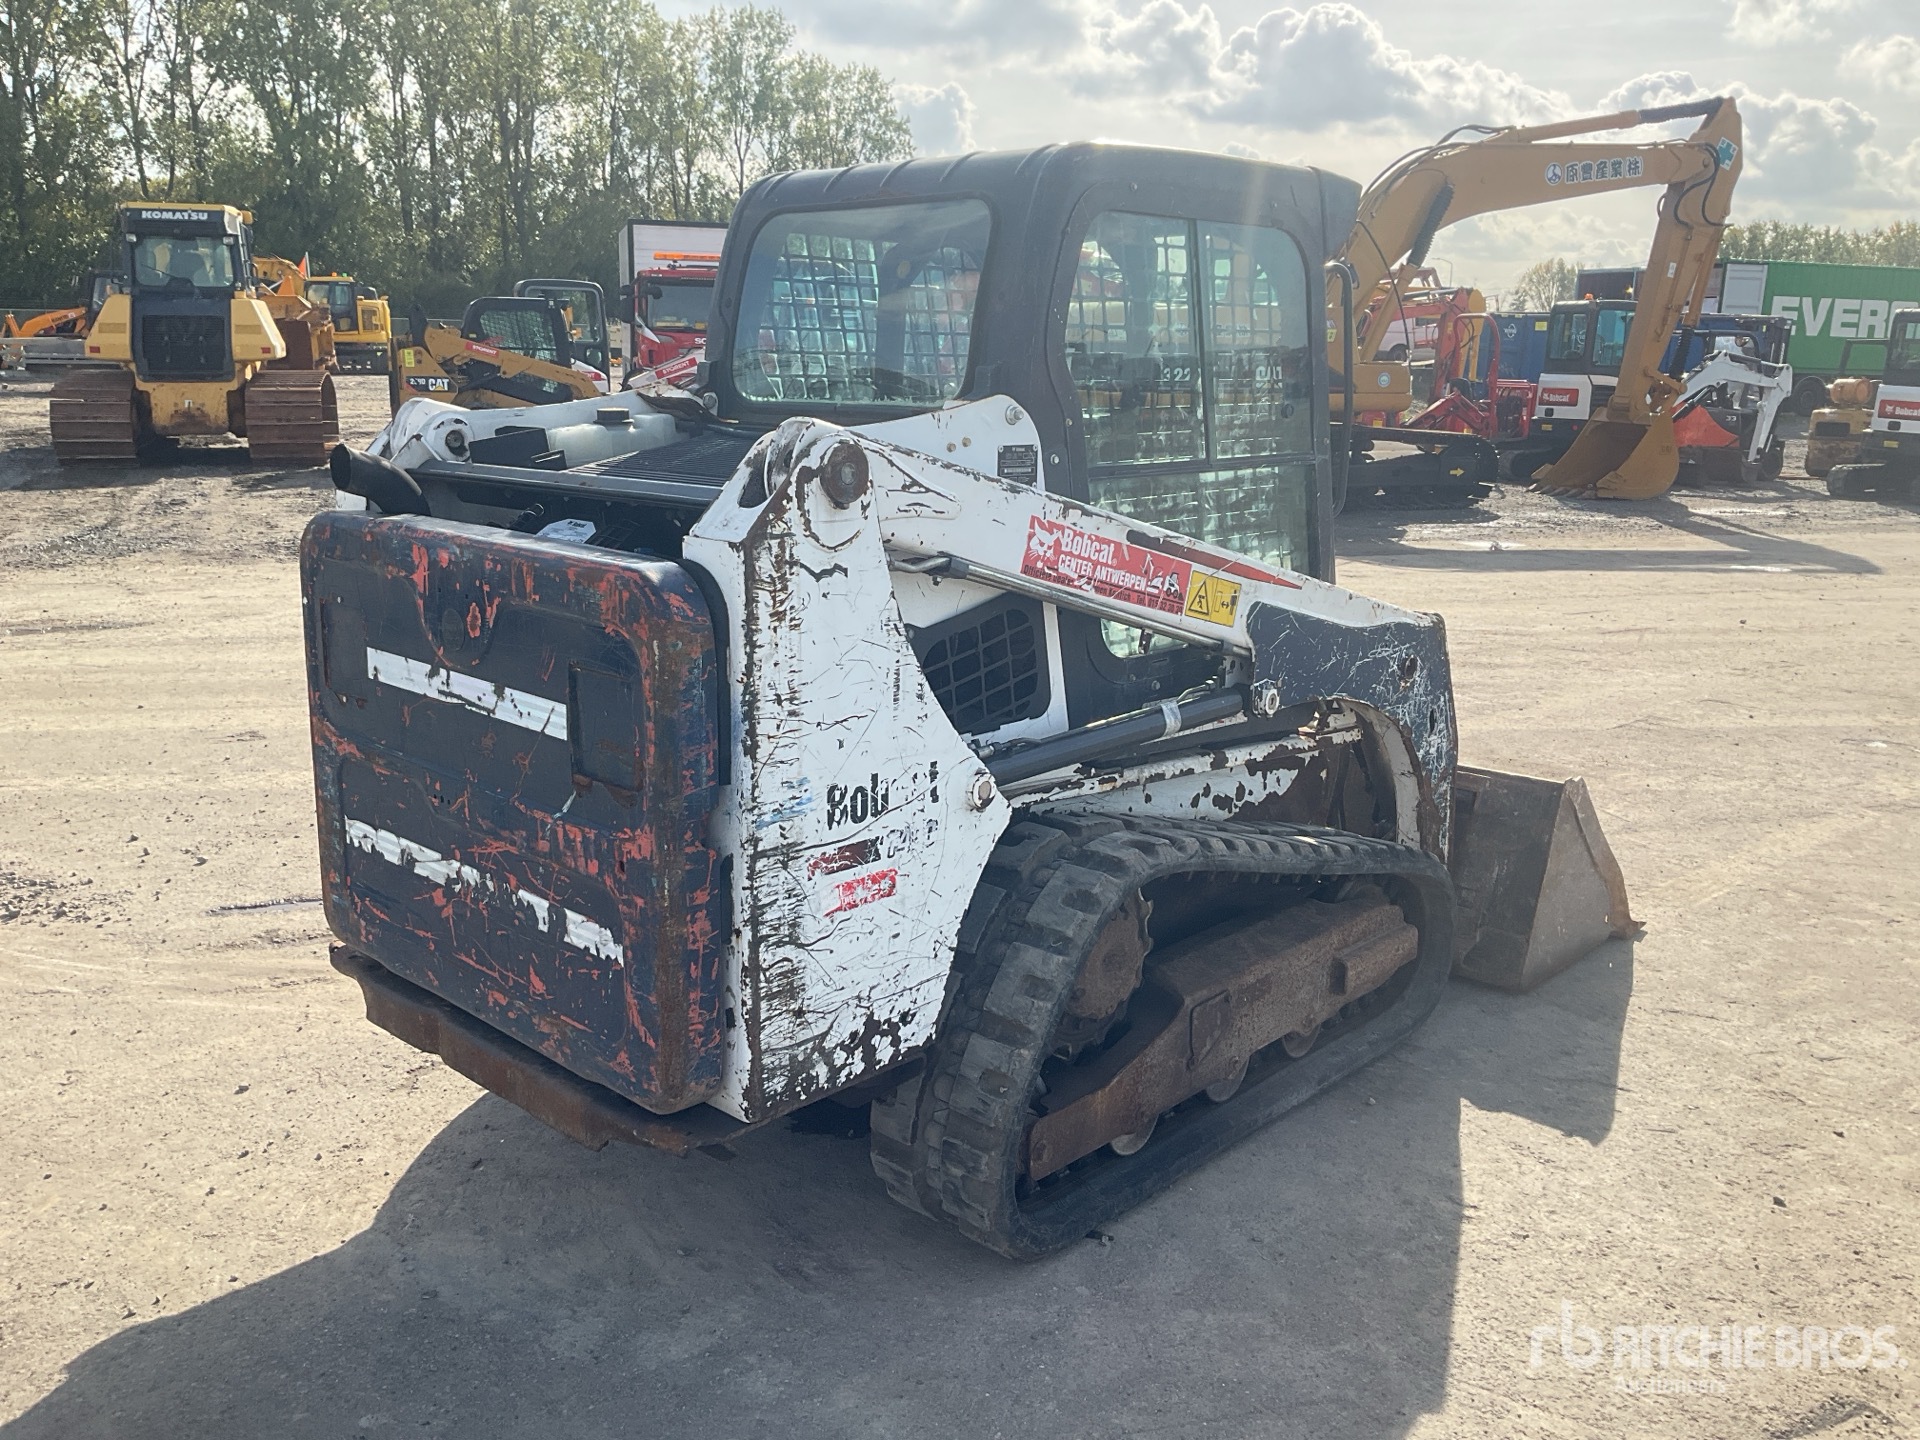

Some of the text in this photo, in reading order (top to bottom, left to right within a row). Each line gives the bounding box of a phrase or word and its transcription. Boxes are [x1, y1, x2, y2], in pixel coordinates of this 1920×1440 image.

[142, 210, 208, 220] KOMATSU
[662, 360, 690, 374] STORENT
[428, 378, 449, 391] CAT
[1549, 394, 1570, 402] Bobcat
[1895, 406, 1920, 416] Bobca
[1062, 528, 1115, 565] Bobcat
[1058, 554, 1147, 591] CENTER ANTWERPEN
